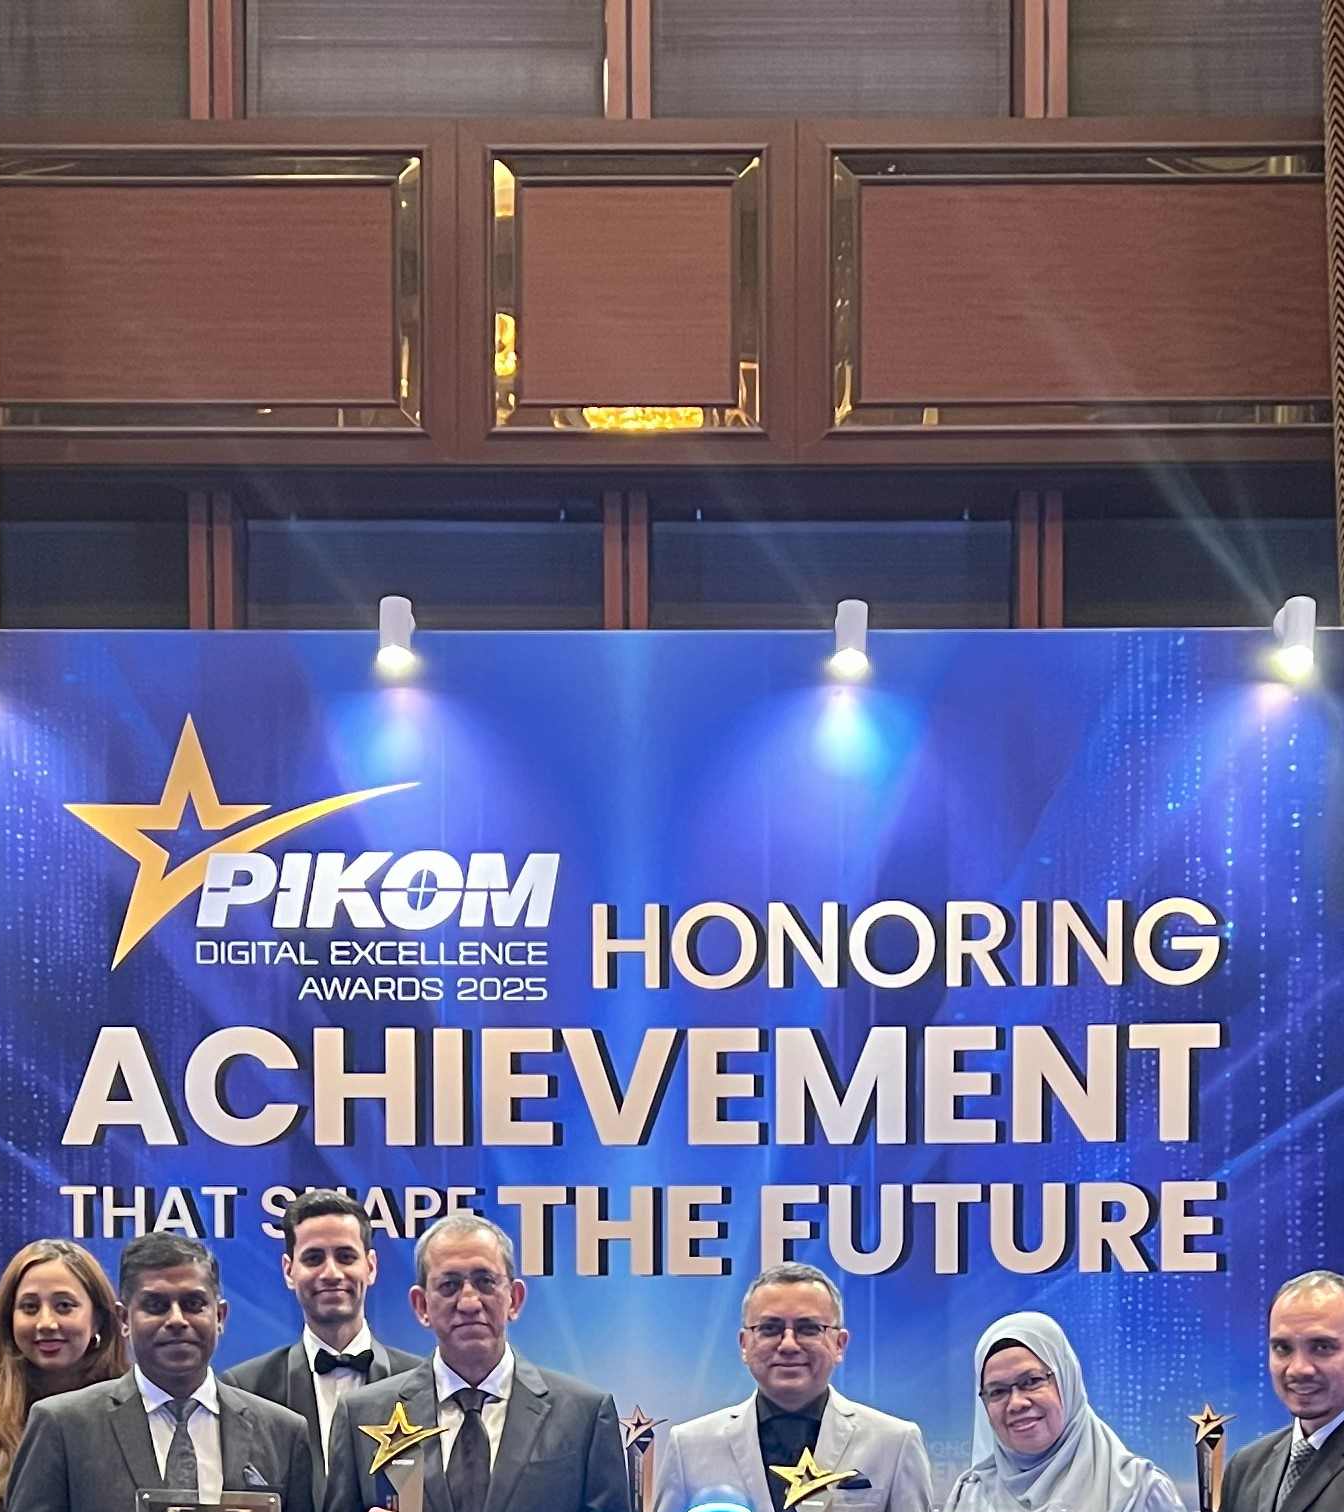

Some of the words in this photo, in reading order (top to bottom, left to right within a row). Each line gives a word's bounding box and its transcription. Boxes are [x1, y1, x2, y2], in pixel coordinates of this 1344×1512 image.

[195, 850, 561, 930] PIKOM
[196, 940, 319, 966] DIGITAL
[329, 940, 549, 967] EXCELLENCE
[593, 898, 1222, 989] HONORING
[298, 977, 444, 1001] AWARDS
[456, 977, 548, 1001] 2025
[60, 1023, 1221, 1147] ACHIEVEMENT
[59, 1185, 239, 1239] THAT
[260, 1185, 477, 1239] SAPE
[497, 1185, 733, 1277] THE
[759, 1180, 1219, 1275] FUTURE
